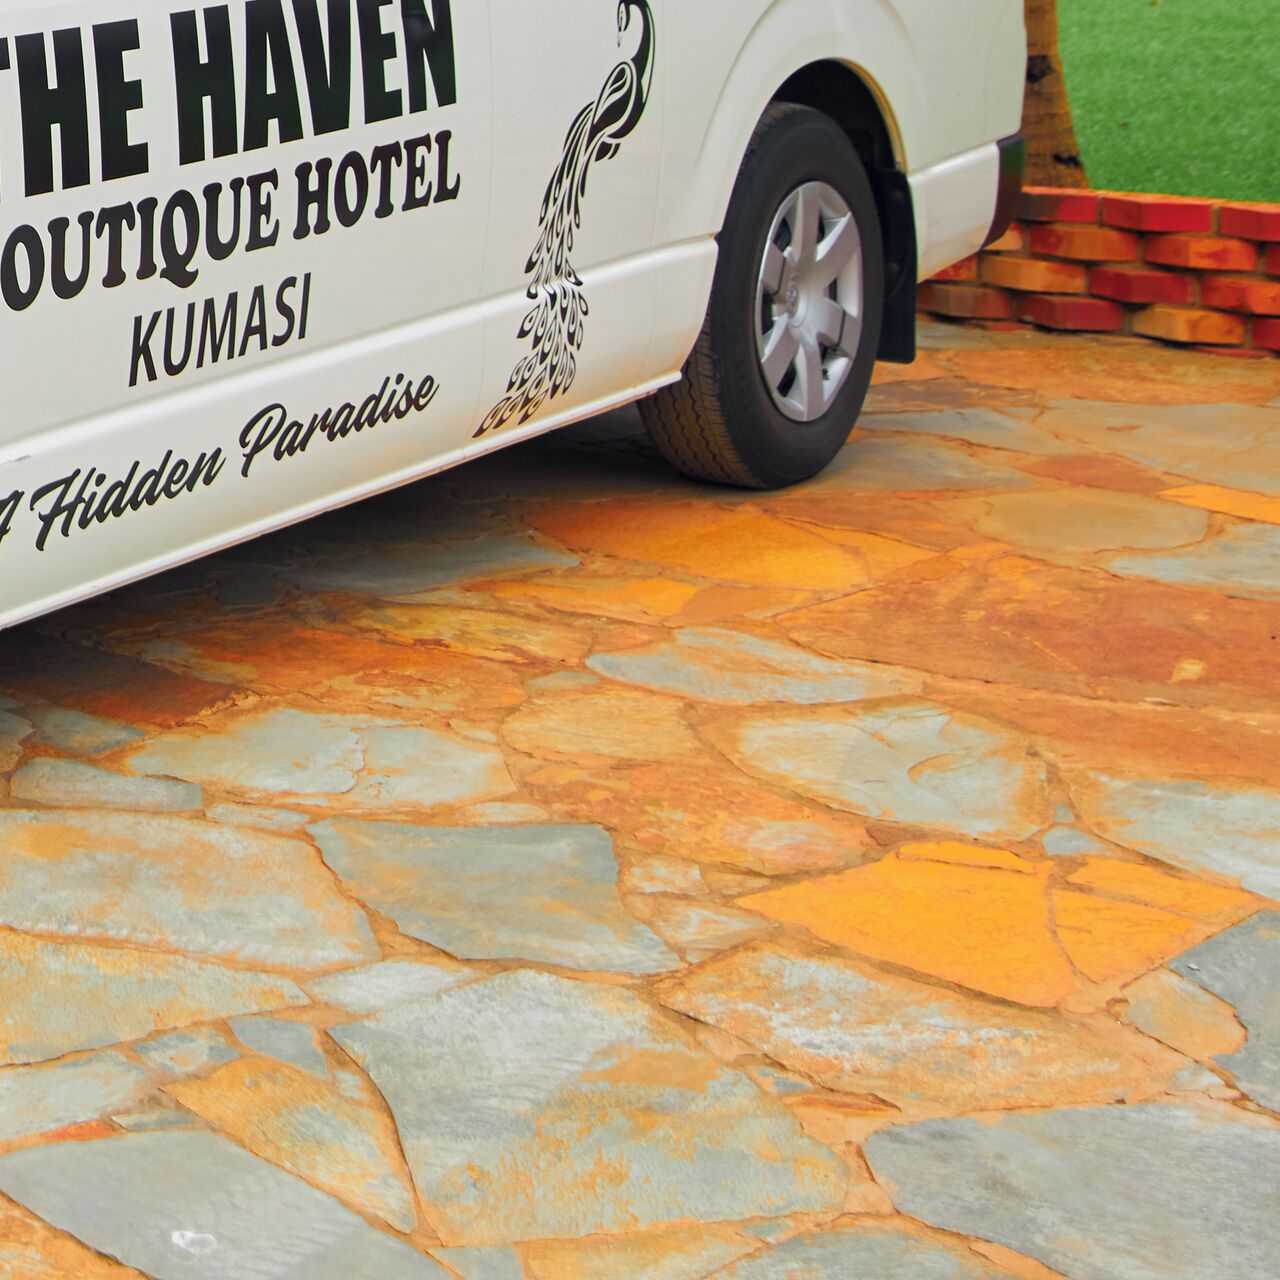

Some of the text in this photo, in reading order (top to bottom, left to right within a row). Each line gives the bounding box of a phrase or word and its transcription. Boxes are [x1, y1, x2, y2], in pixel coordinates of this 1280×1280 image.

[293, 130, 460, 239] HOTEL
[129, 273, 311, 387] KUMASI
[30, 448, 226, 551] Hidden
[239, 374, 439, 477] Paradise
